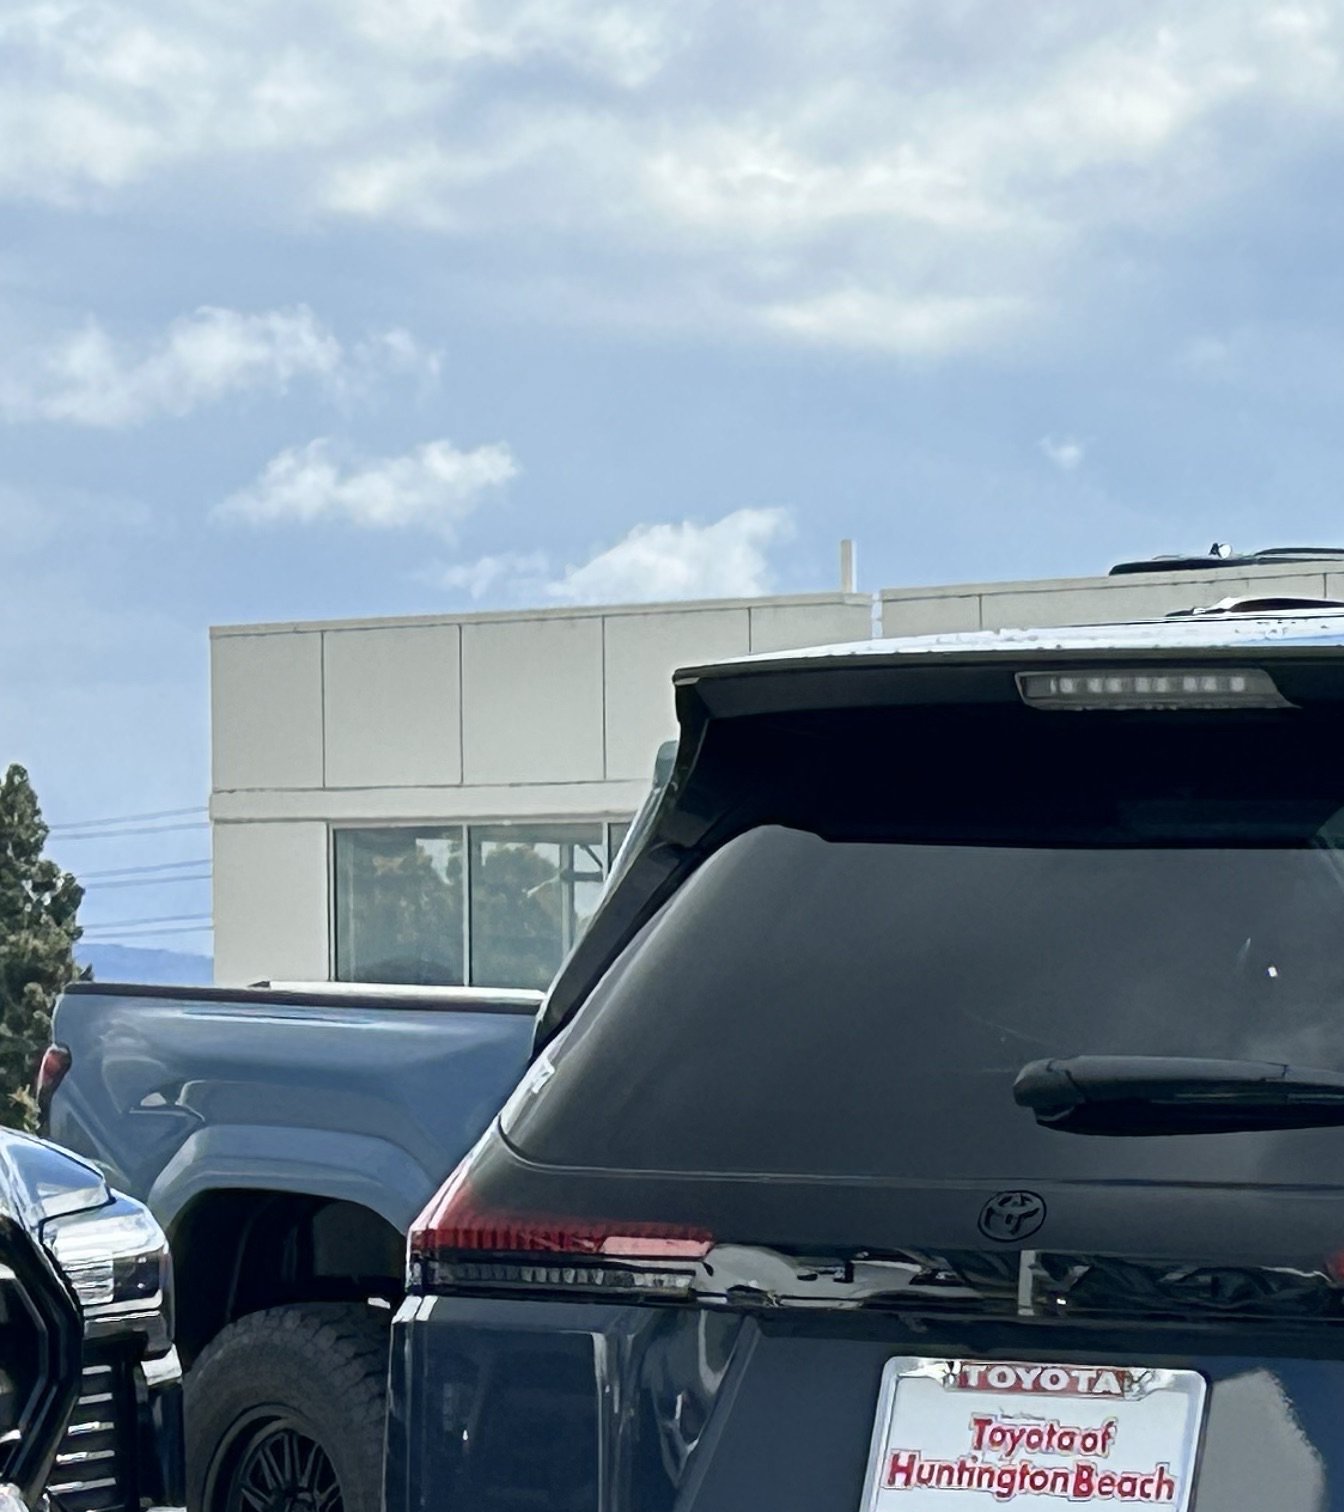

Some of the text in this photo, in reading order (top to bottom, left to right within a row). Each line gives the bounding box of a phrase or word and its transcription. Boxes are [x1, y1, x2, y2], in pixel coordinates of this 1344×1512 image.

[963, 1364, 1122, 1394] TOYOTA
[971, 1417, 1116, 1456] Toyota of
[887, 1453, 1175, 1501] Huntington Beach
